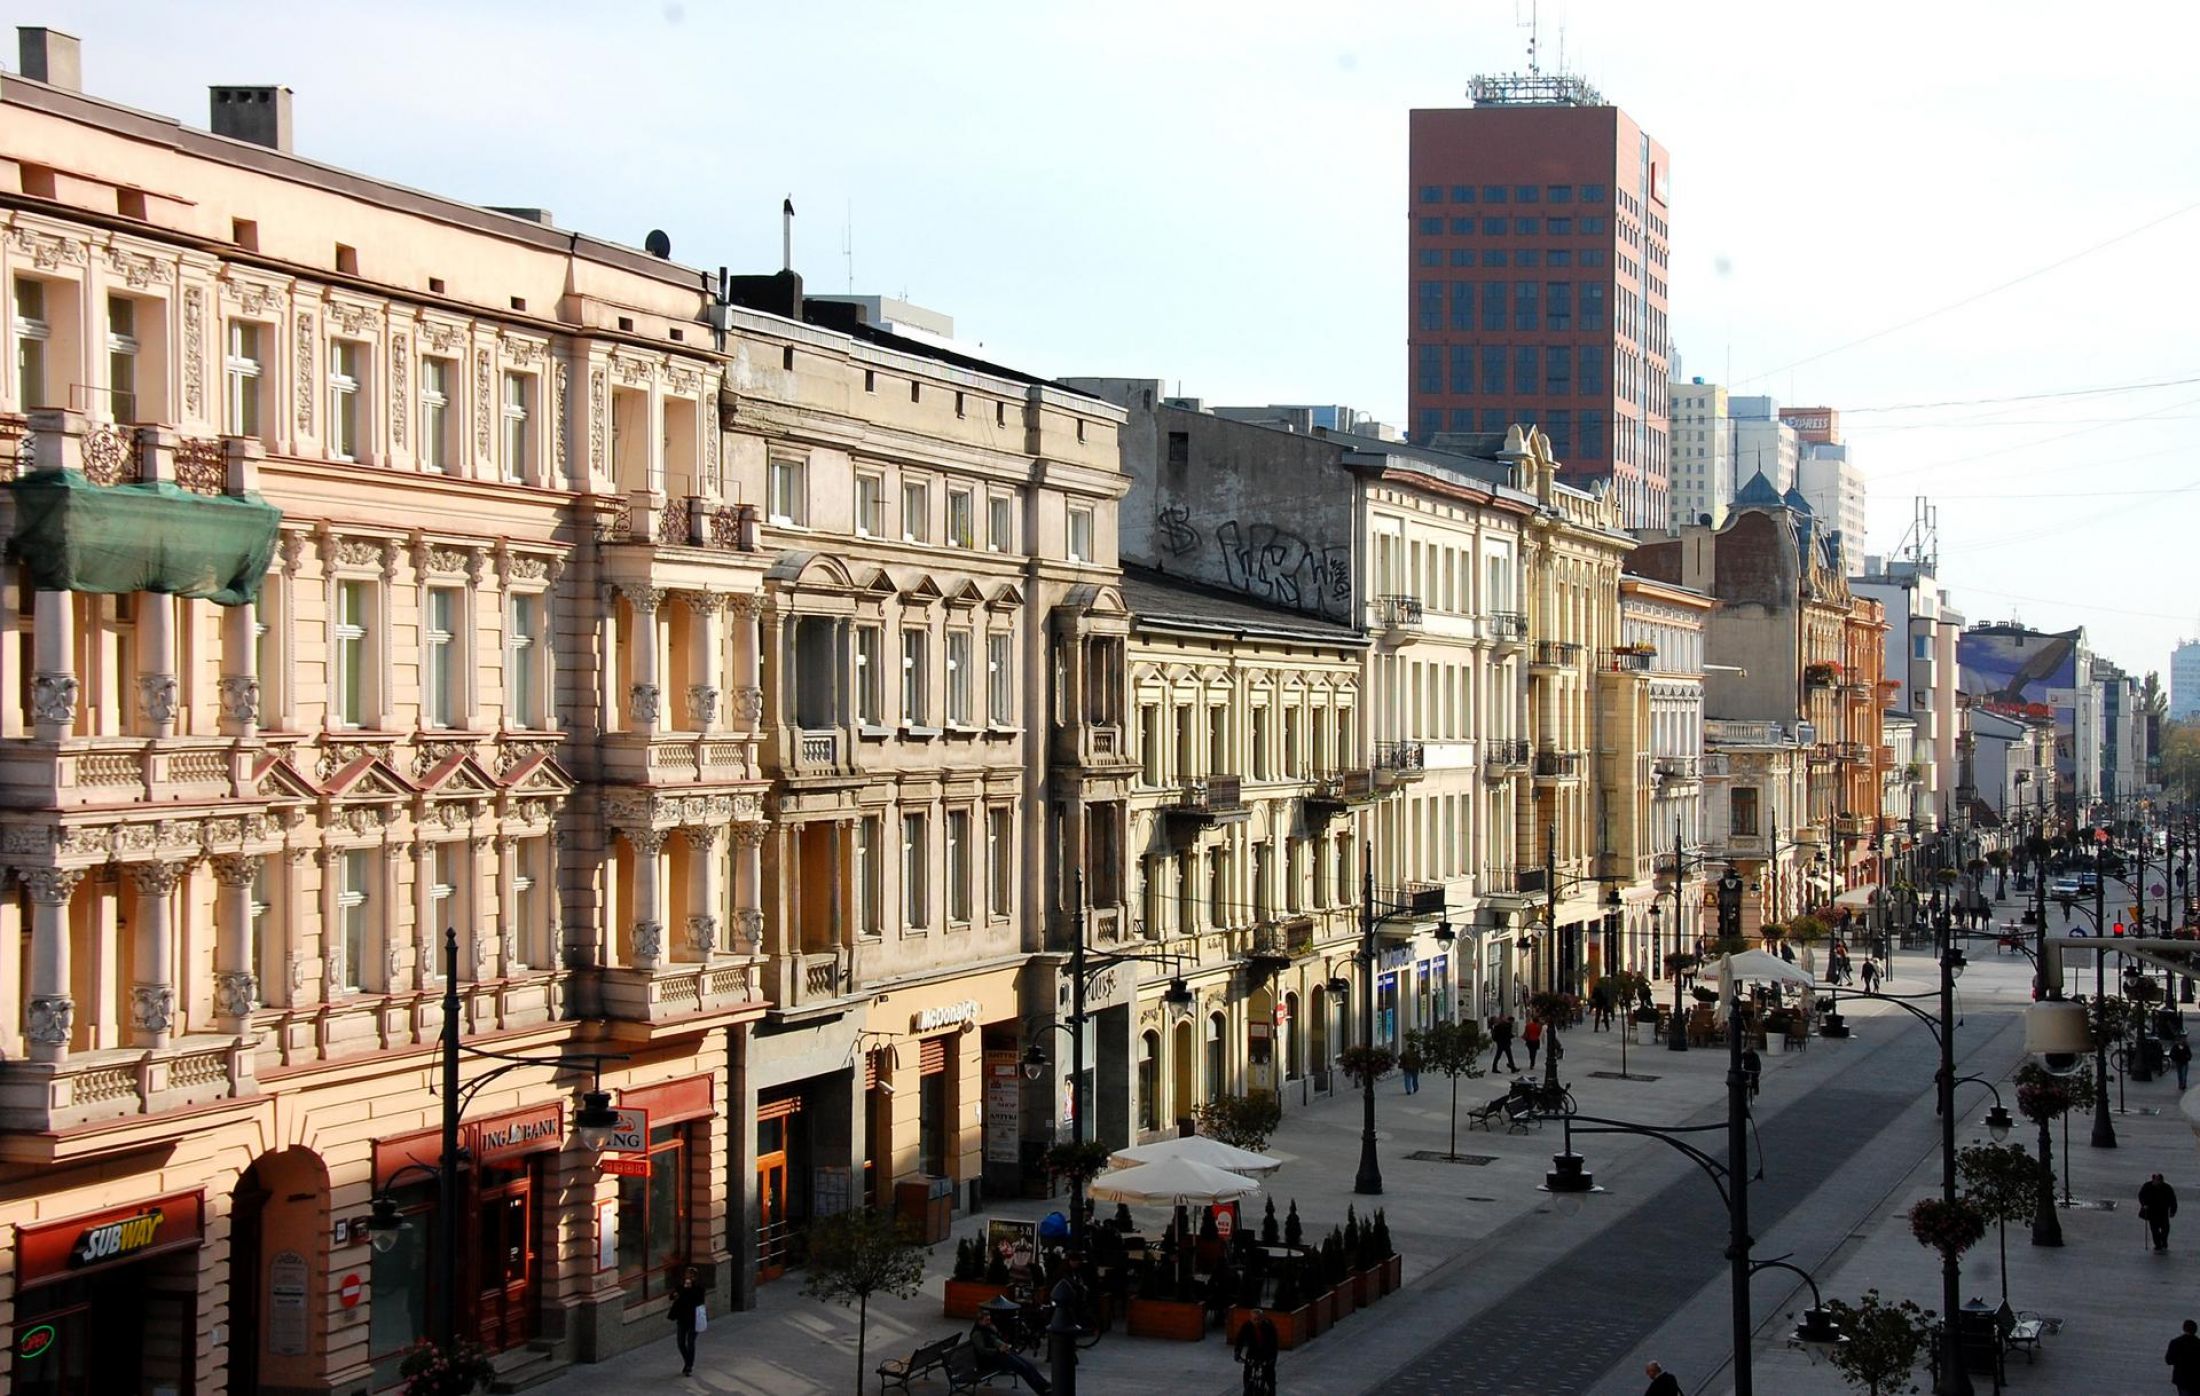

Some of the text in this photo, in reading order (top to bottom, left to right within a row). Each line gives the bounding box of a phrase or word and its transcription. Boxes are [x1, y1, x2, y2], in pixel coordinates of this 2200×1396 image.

[1788, 416, 1828, 429] EXPRESS
[915, 1001, 978, 1031] McDonald's
[522, 1118, 557, 1142] BANK
[83, 1213, 165, 1262] SUBWAY
